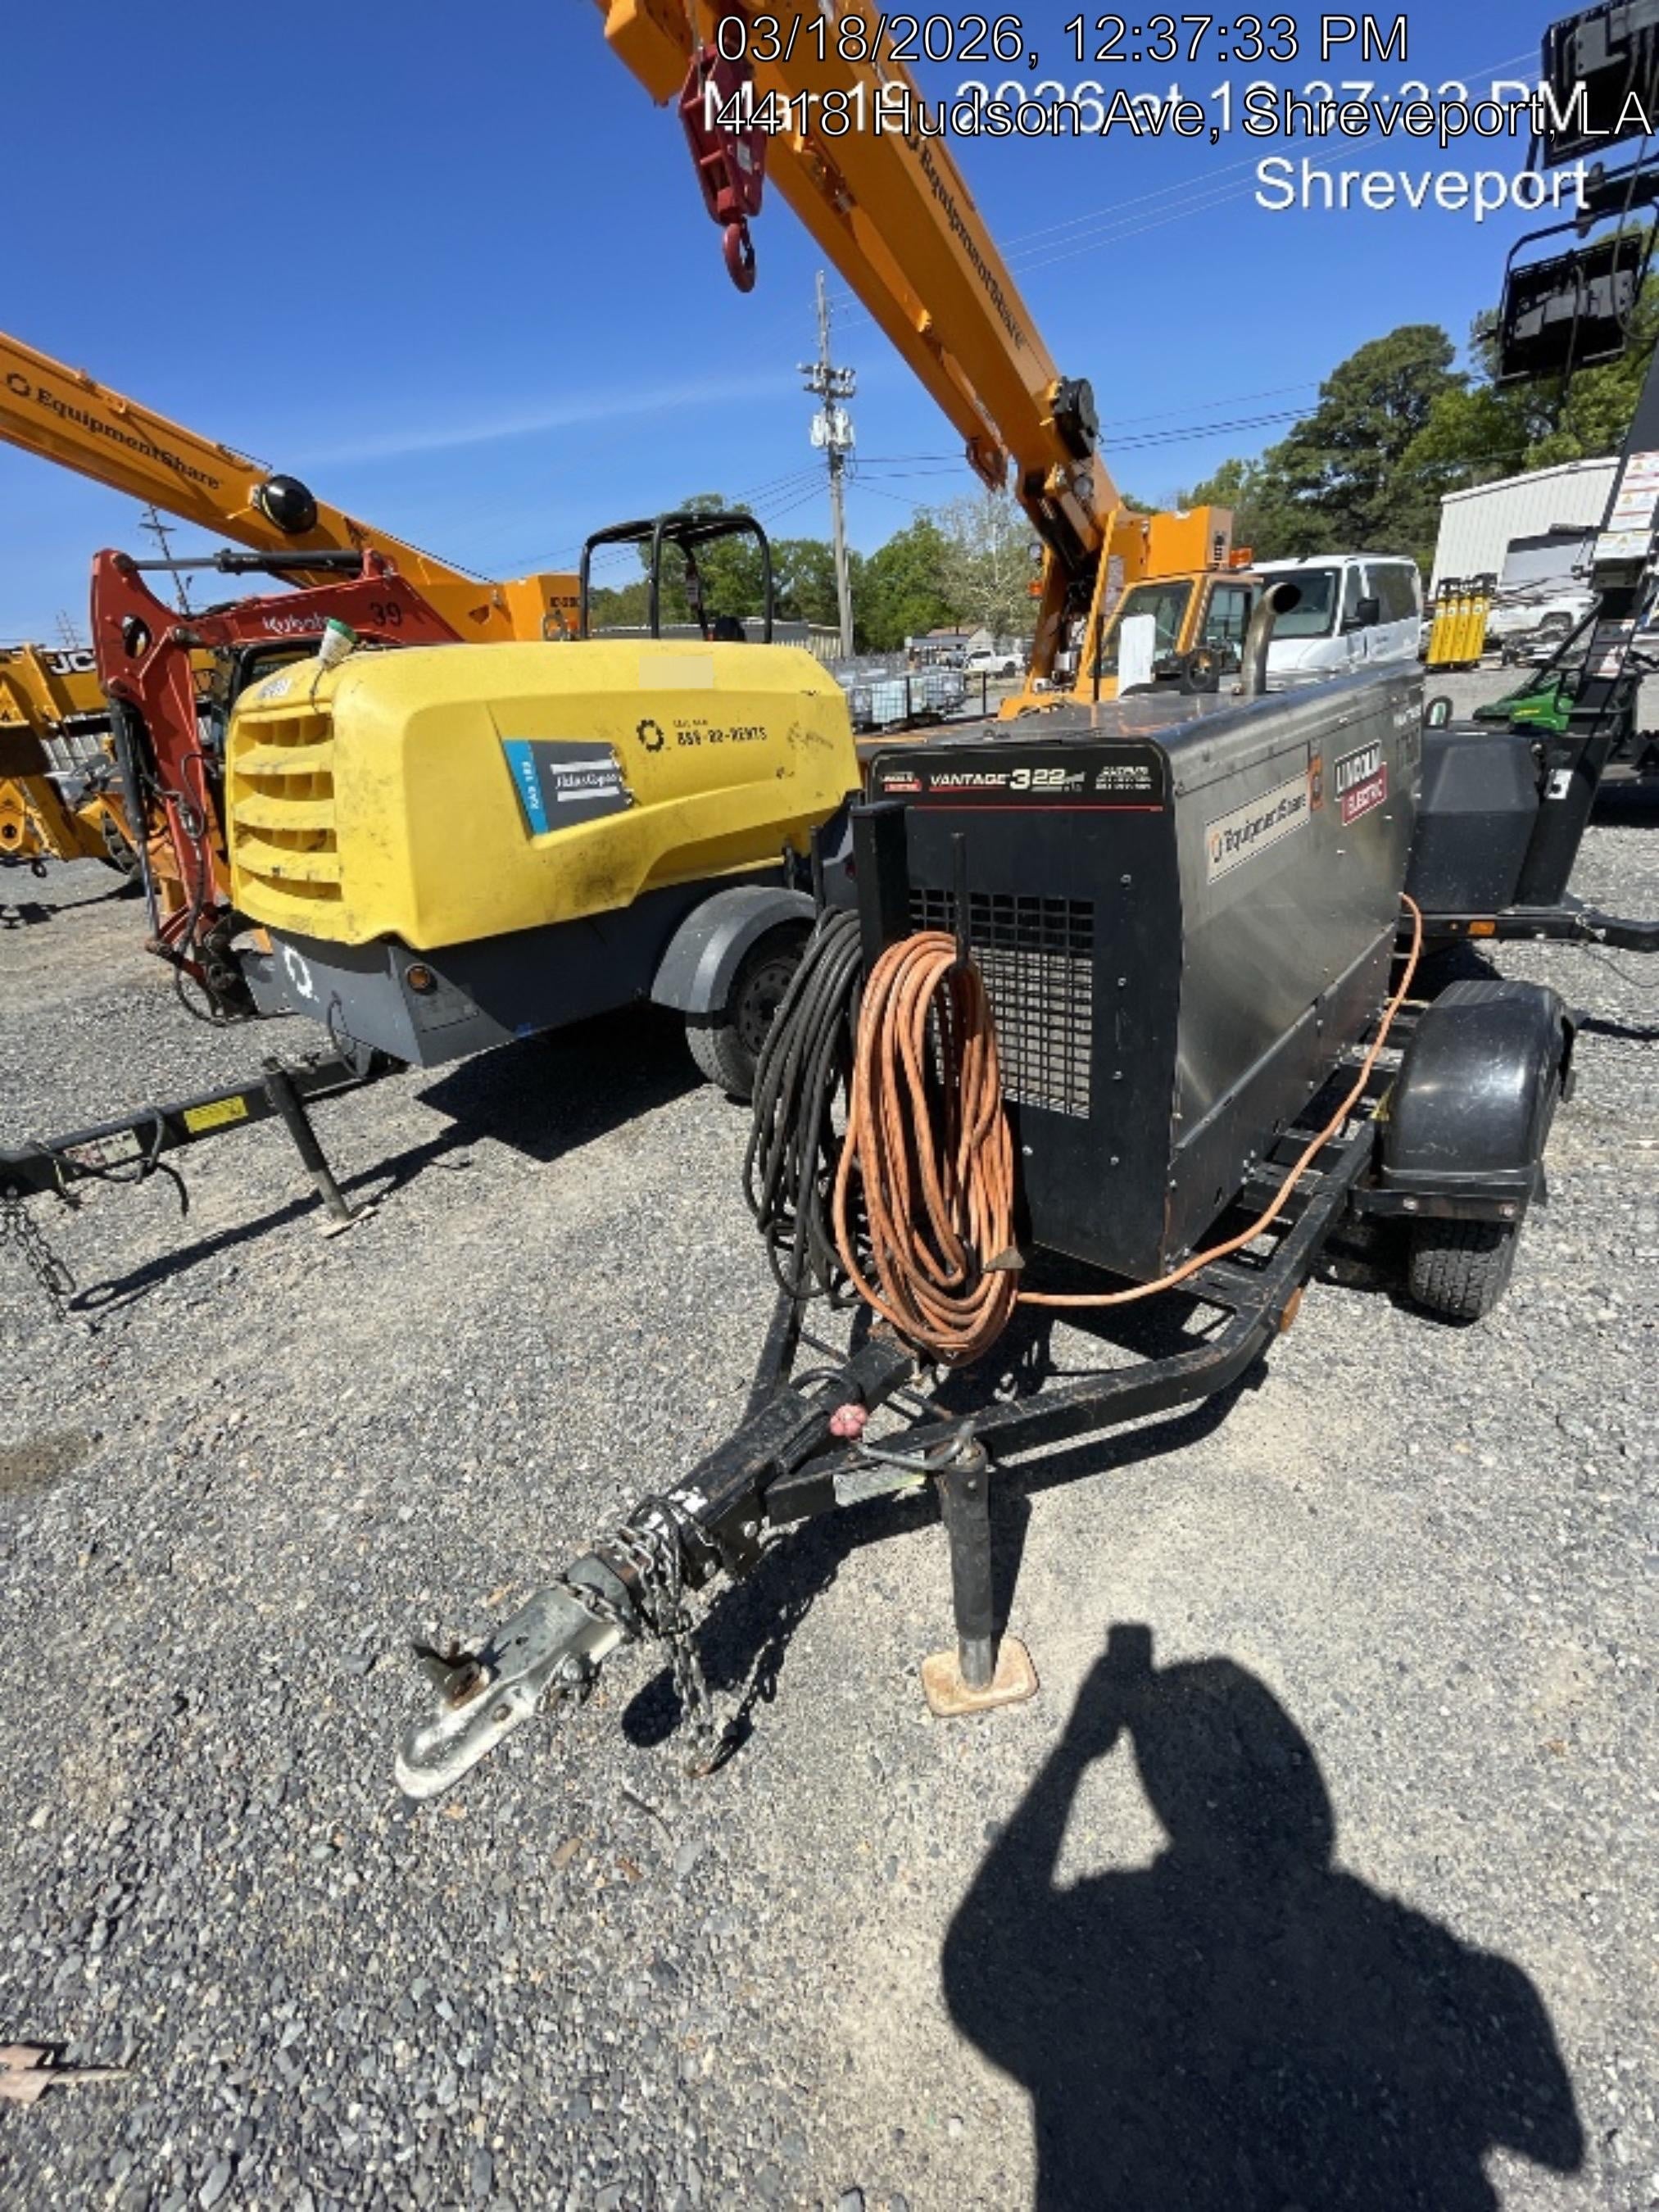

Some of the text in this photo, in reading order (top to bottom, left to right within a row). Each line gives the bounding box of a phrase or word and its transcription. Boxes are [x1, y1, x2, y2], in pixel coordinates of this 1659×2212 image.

[37, 388, 220, 490] EquipmentShare
[370, 602, 402, 628] 39
[50, 651, 96, 674] JC
[931, 773, 1007, 786] VANTAGE
[1009, 768, 1066, 790] 322
